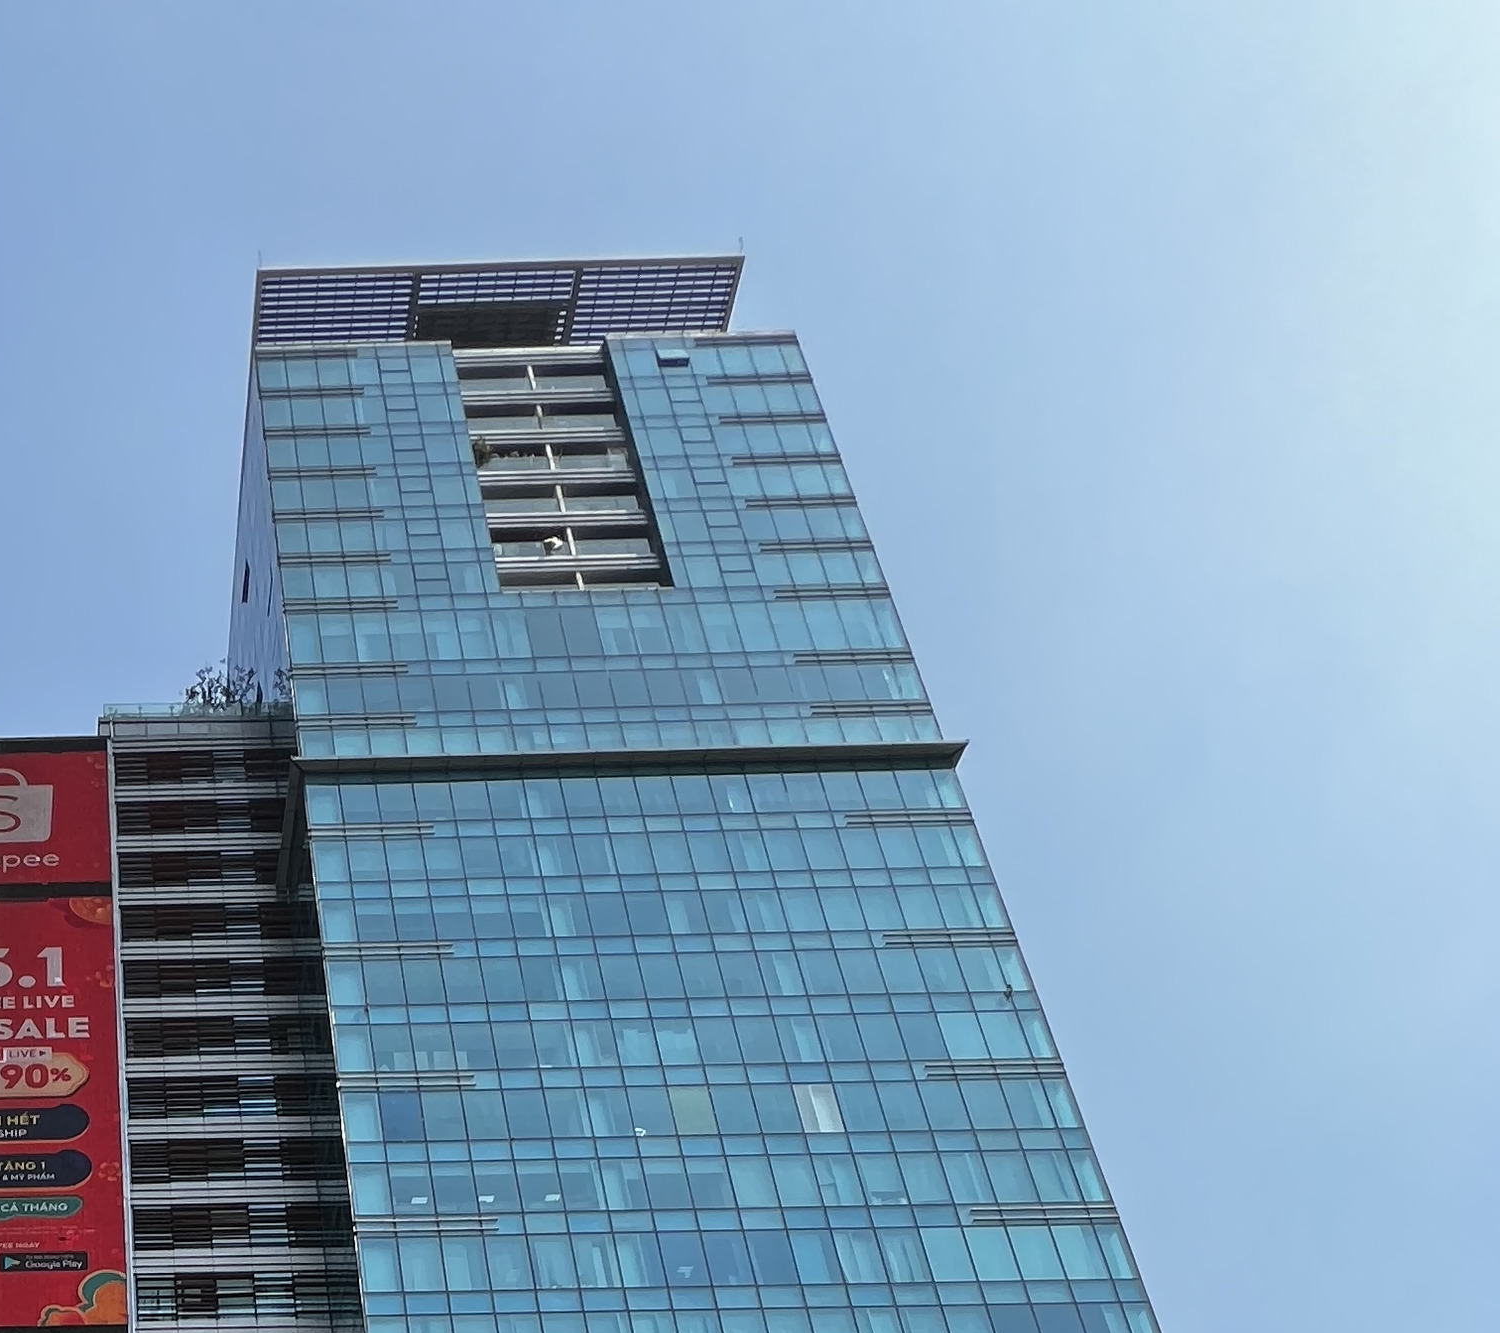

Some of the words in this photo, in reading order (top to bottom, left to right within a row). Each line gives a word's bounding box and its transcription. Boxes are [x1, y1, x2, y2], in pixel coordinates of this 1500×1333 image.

[23, 994, 75, 1009] LIVE
[8, 1048, 37, 1059] LIVE
[0, 1062, 72, 1090] 90%
[22, 1202, 69, 1213] THÁNG
[25, 1260, 61, 1271] Google
[62, 1259, 83, 1270] Play
